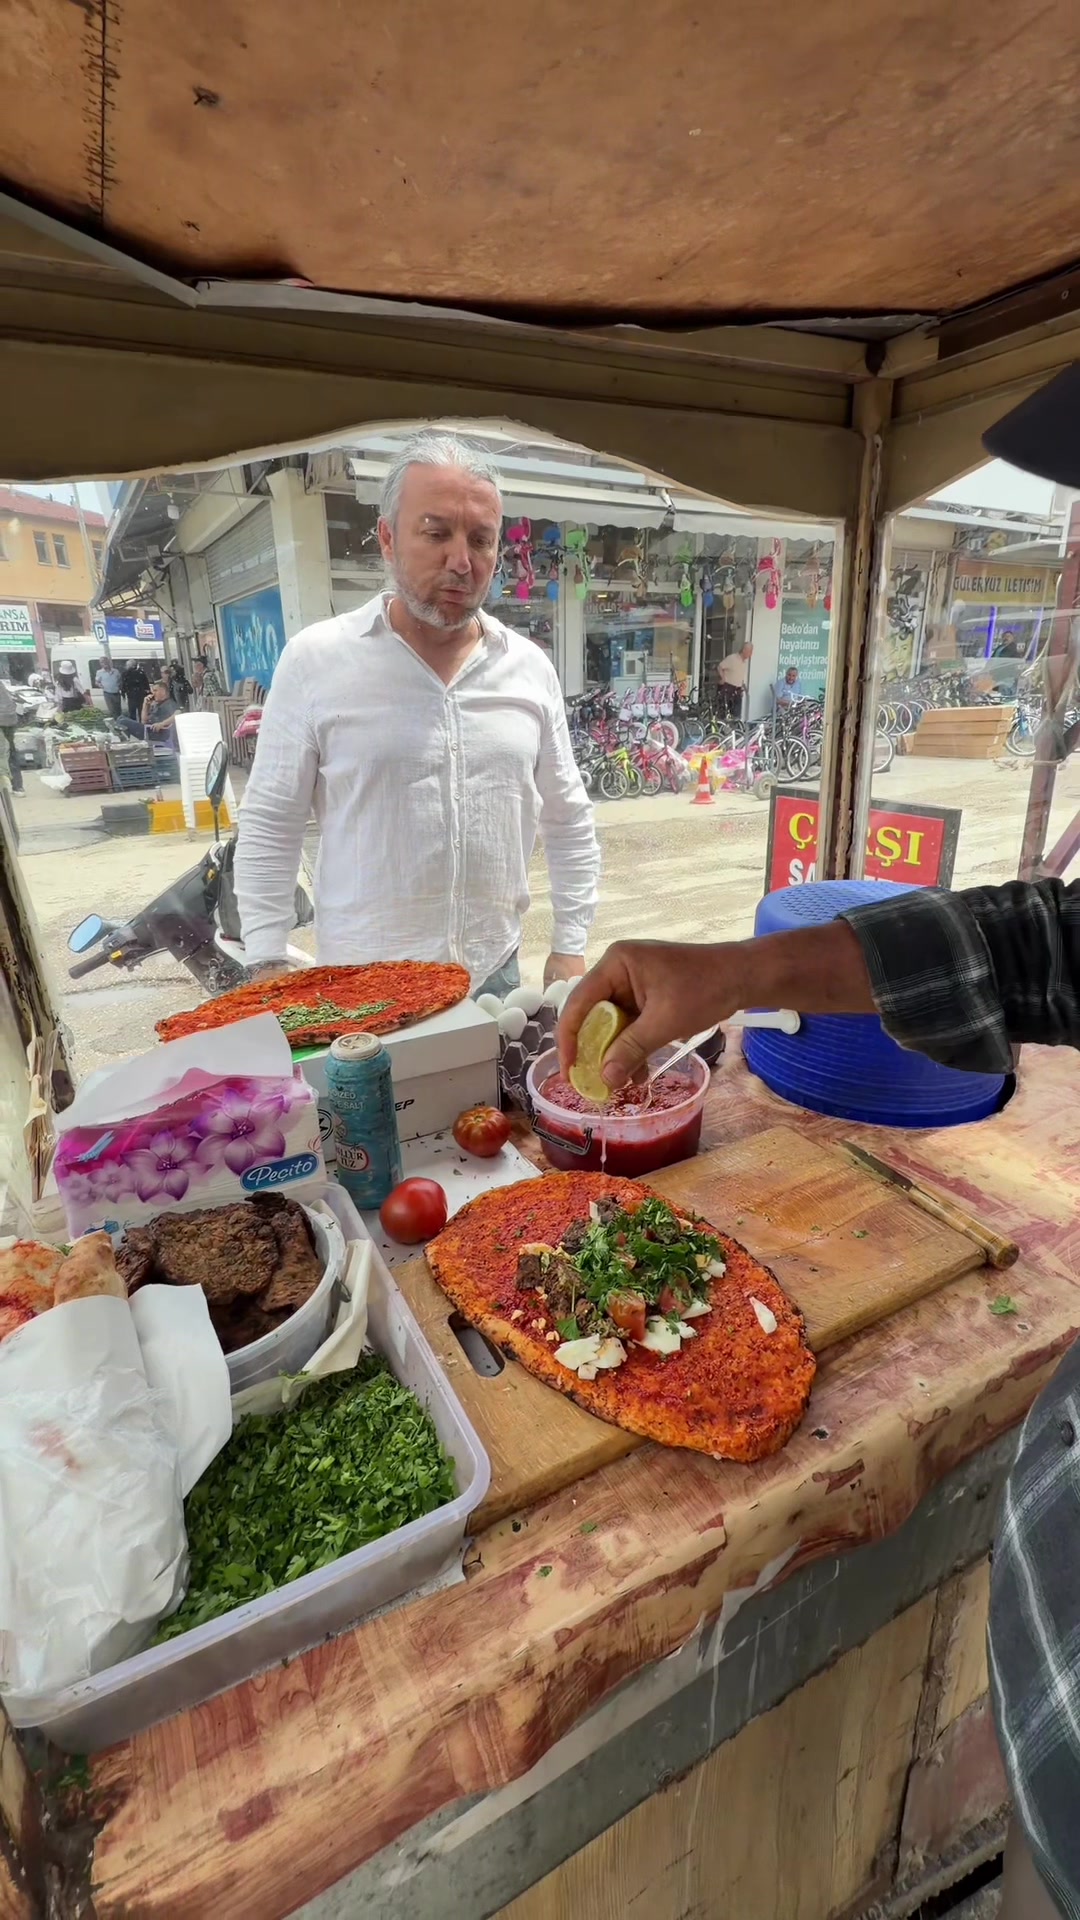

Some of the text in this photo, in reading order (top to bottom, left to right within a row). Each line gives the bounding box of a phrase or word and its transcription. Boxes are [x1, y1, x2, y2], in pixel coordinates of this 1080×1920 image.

[781, 623, 819, 635] Beko'dan
[788, 812, 925, 867] ÇŞI
[246, 1160, 313, 1186] Peçito
